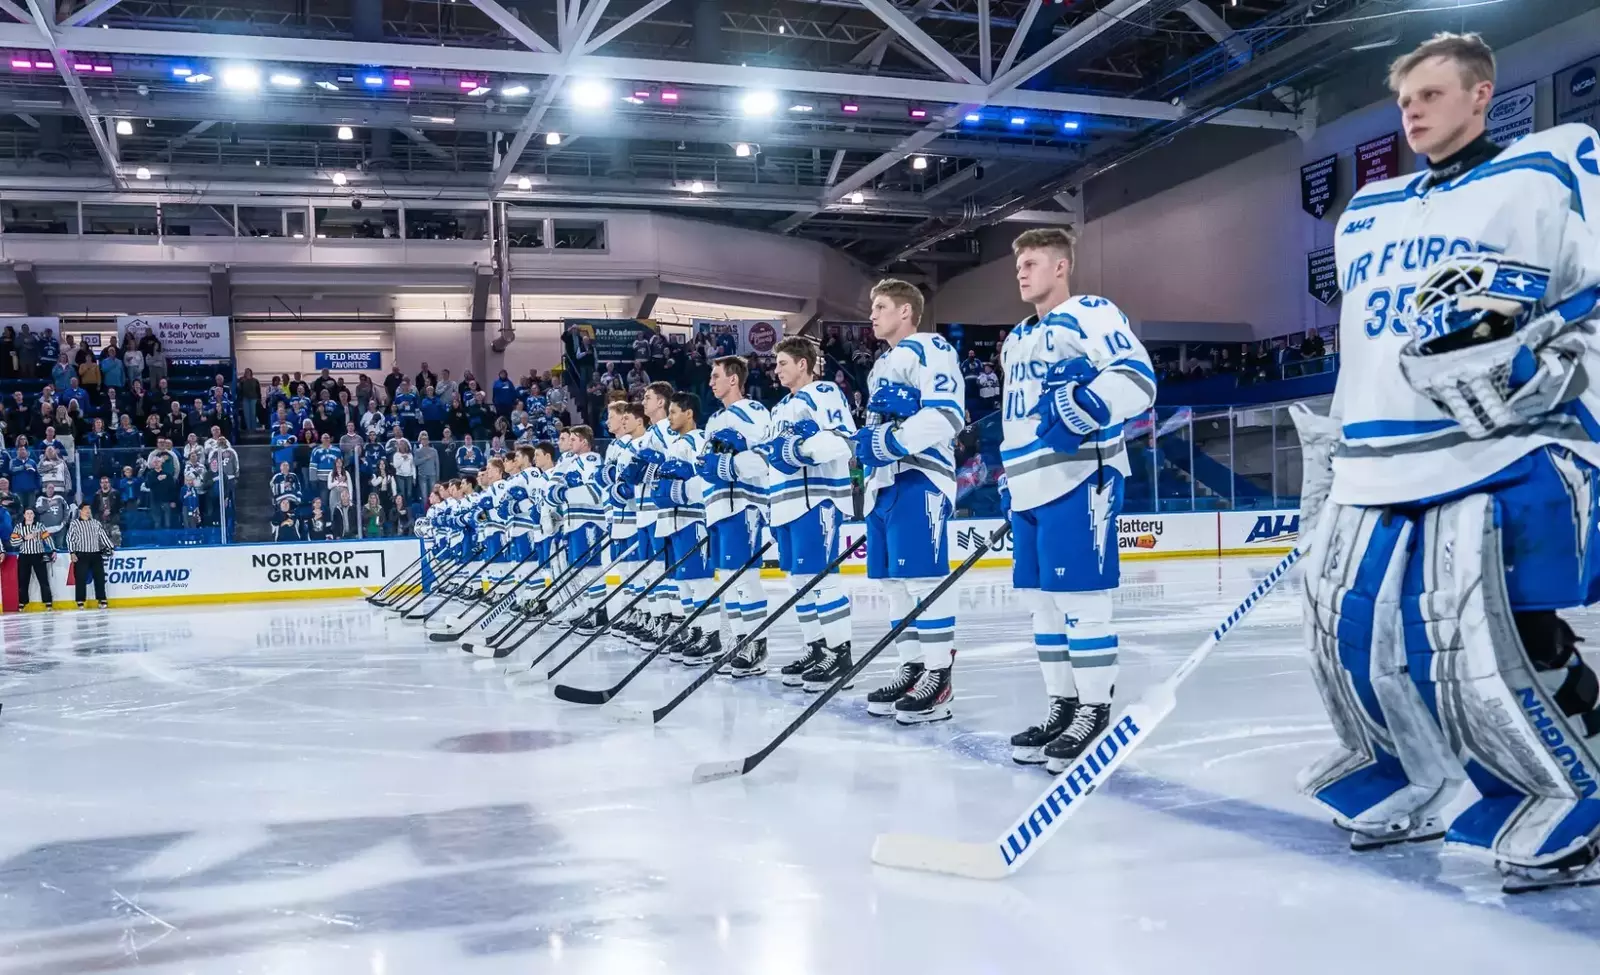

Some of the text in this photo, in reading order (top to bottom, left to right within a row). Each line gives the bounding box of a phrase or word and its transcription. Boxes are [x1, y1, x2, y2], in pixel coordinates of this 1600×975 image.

[159, 322, 208, 330] Mike Porter
[168, 331, 188, 340] Sally
[191, 331, 220, 340] Vargas
[1045, 331, 1054, 351] C
[1104, 330, 1132, 355] 10
[332, 361, 368, 369] FAVORITES
[827, 409, 843, 423] 14
[1245, 515, 1300, 543] AH
[1119, 537, 1138, 548] aw
[252, 551, 354, 567] NORTHROP
[268, 566, 369, 582] GRUMMAN
[144, 582, 170, 590] Squared
[1214, 547, 1301, 641] WARRIOR
[1515, 687, 1598, 798] VAUGHN
[1000, 714, 1141, 866] WARRIOR
